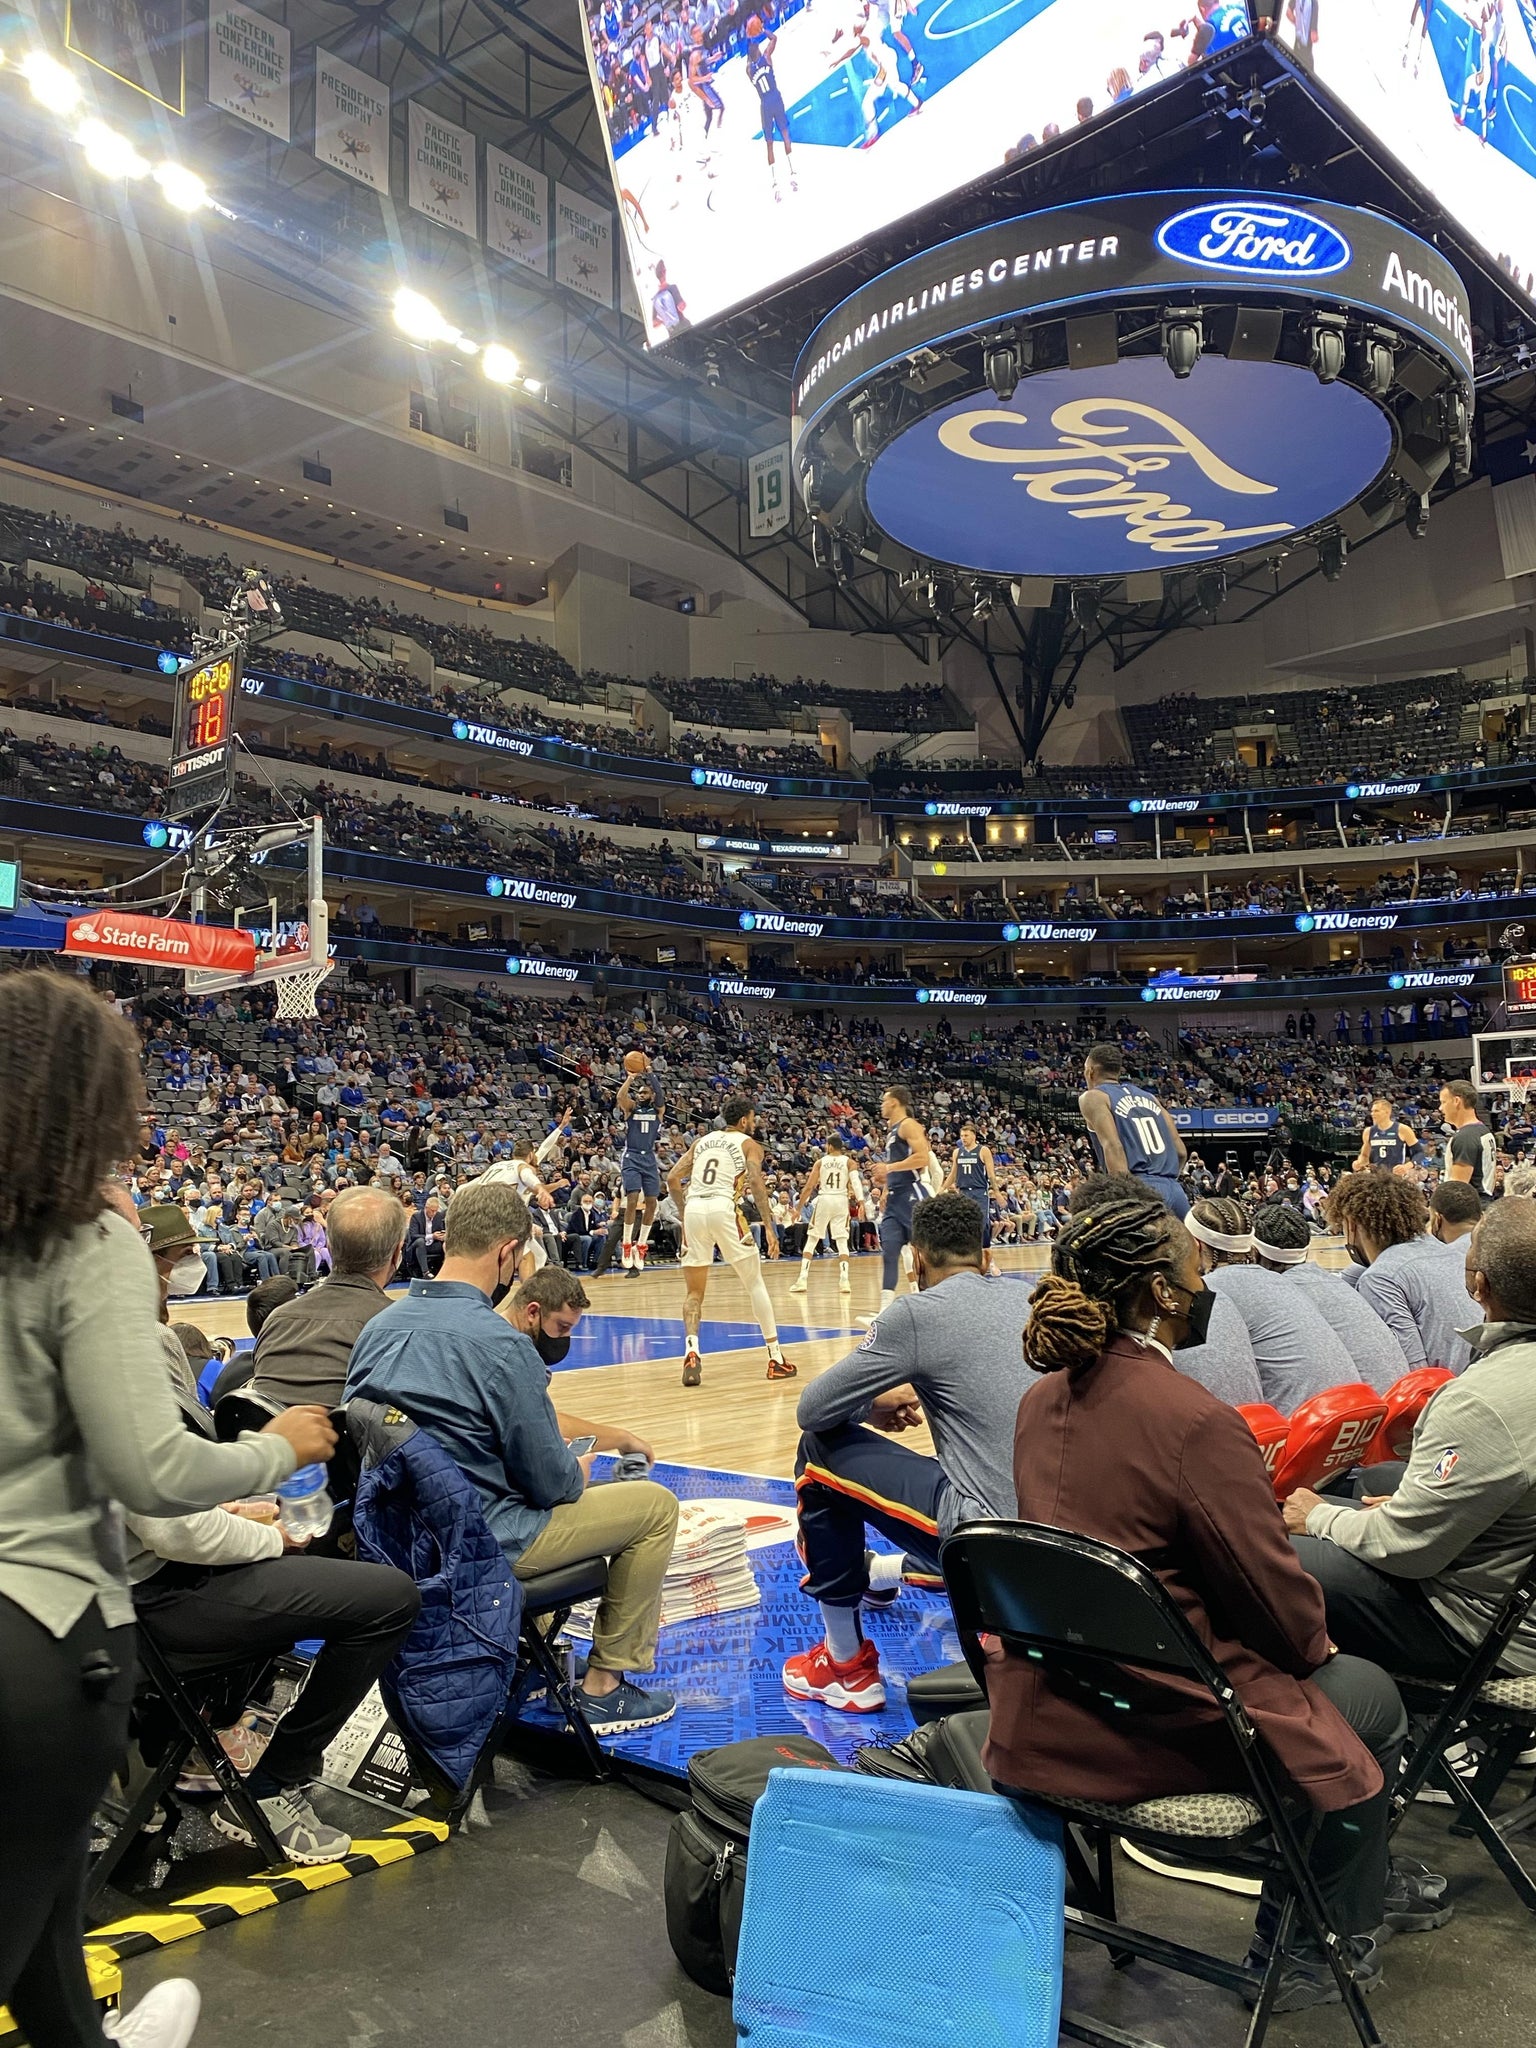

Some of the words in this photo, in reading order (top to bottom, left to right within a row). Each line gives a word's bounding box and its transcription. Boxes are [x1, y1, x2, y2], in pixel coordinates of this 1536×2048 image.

[215, 21, 285, 70] CONFERENCE
[225, 10, 275, 49] WESTERN
[218, 40, 282, 84] CHAMPIONS
[321, 71, 386, 117] PRESIDENTS'
[334, 94, 373, 127] TROPHY
[424, 136, 463, 168] DIVISION
[425, 122, 461, 151] PACIFIC
[417, 150, 470, 186] CHAMPIONS
[498, 162, 537, 195] CENTRAL
[494, 191, 542, 226] CHAMPIONS
[500, 178, 536, 208] DIVISION
[569, 223, 600, 249] TROPHY
[1198, 210, 1317, 267] Ford
[757, 468, 782, 514] 19
[937, 397, 1296, 553] Ford
[186, 747, 225, 773] TISSOT
[743, 841, 760, 851] CLUB
[640, 1121, 649, 1134] 11
[1131, 1116, 1166, 1155] 10
[1214, 1113, 1269, 1125] GEICO
[1378, 1146, 1387, 1159] 6
[702, 1158, 719, 1185] 6
[826, 1172, 841, 1190] 41
[1330, 1414, 1384, 1451] BIO
[1323, 1447, 1366, 1467] STEEL
